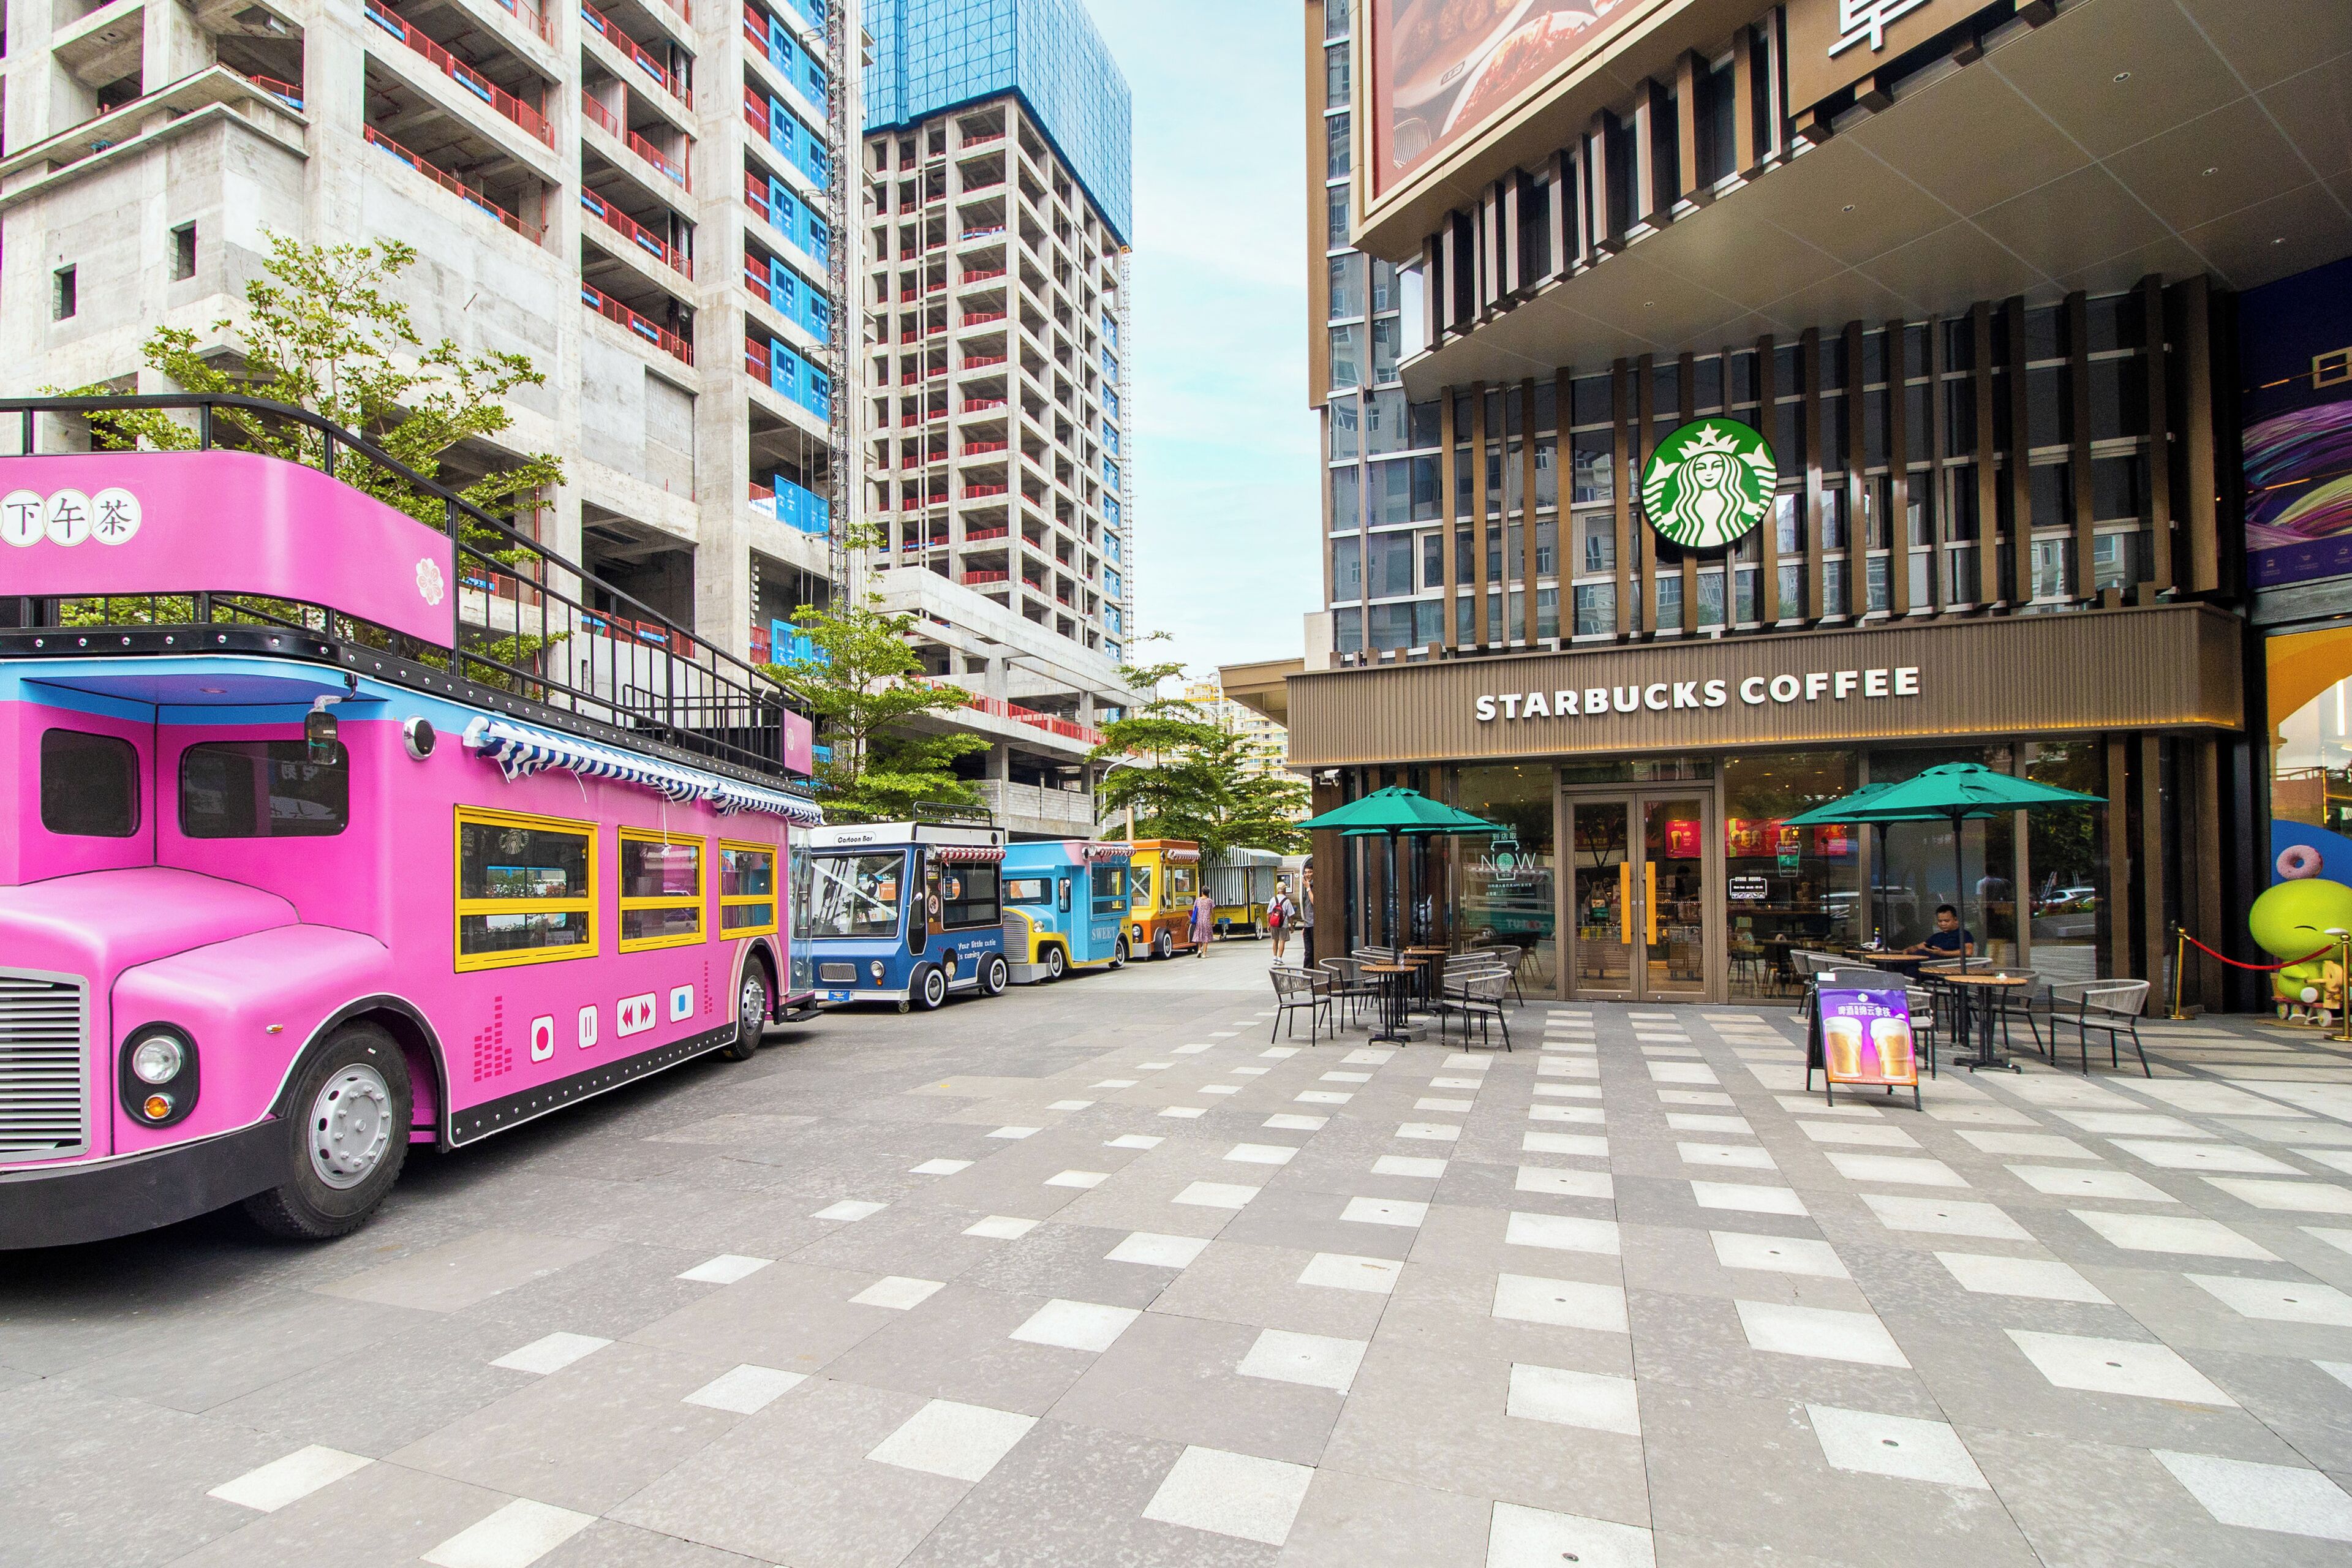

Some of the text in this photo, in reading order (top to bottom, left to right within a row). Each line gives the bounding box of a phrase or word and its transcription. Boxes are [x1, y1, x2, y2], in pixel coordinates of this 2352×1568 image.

[6, 498, 132, 538] 下午茶
[1475, 666, 1920, 721] STARBUCKS COFFEE
[1481, 853, 1536, 870] NOW
[1091, 926, 1115, 941] SWEET
[957, 950, 981, 962] is coming
